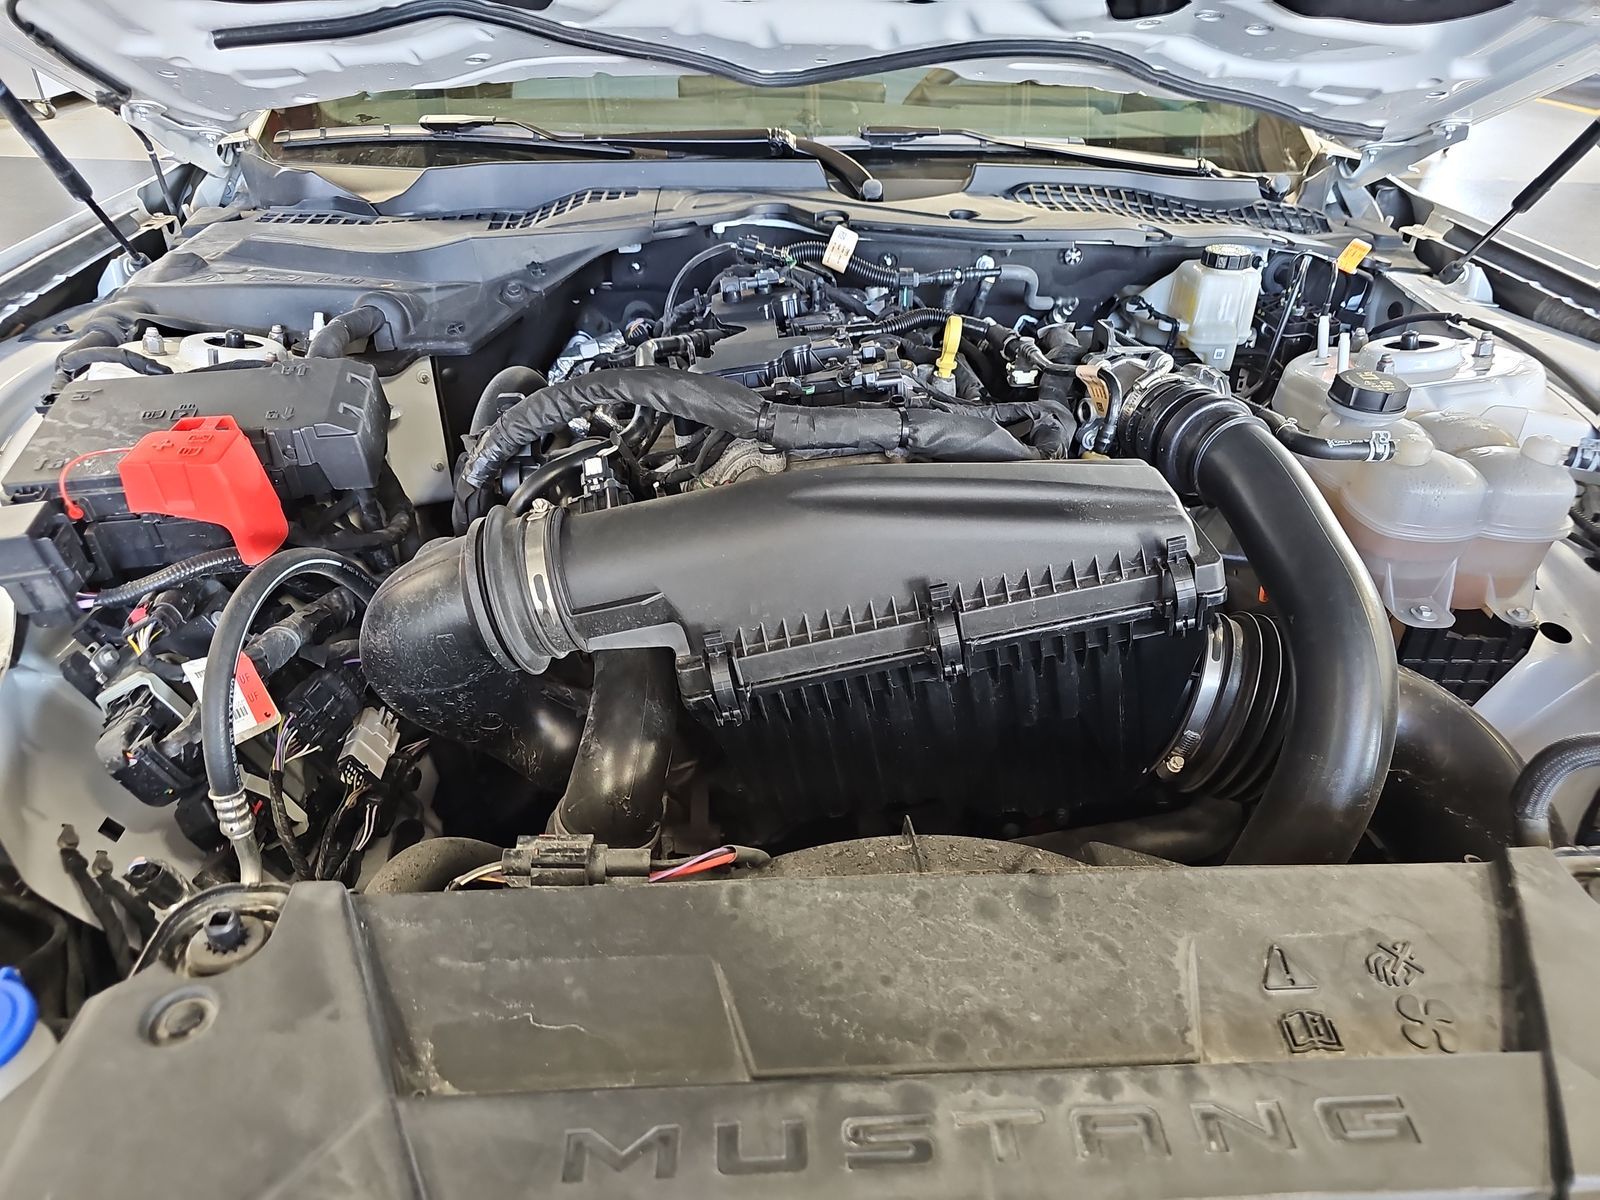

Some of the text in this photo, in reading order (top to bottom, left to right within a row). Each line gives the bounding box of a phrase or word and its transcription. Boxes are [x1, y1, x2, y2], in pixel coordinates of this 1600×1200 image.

[239, 673, 250, 684] UF
[248, 691, 259, 703] UF
[561, 1095, 1422, 1184] MUSTANG
